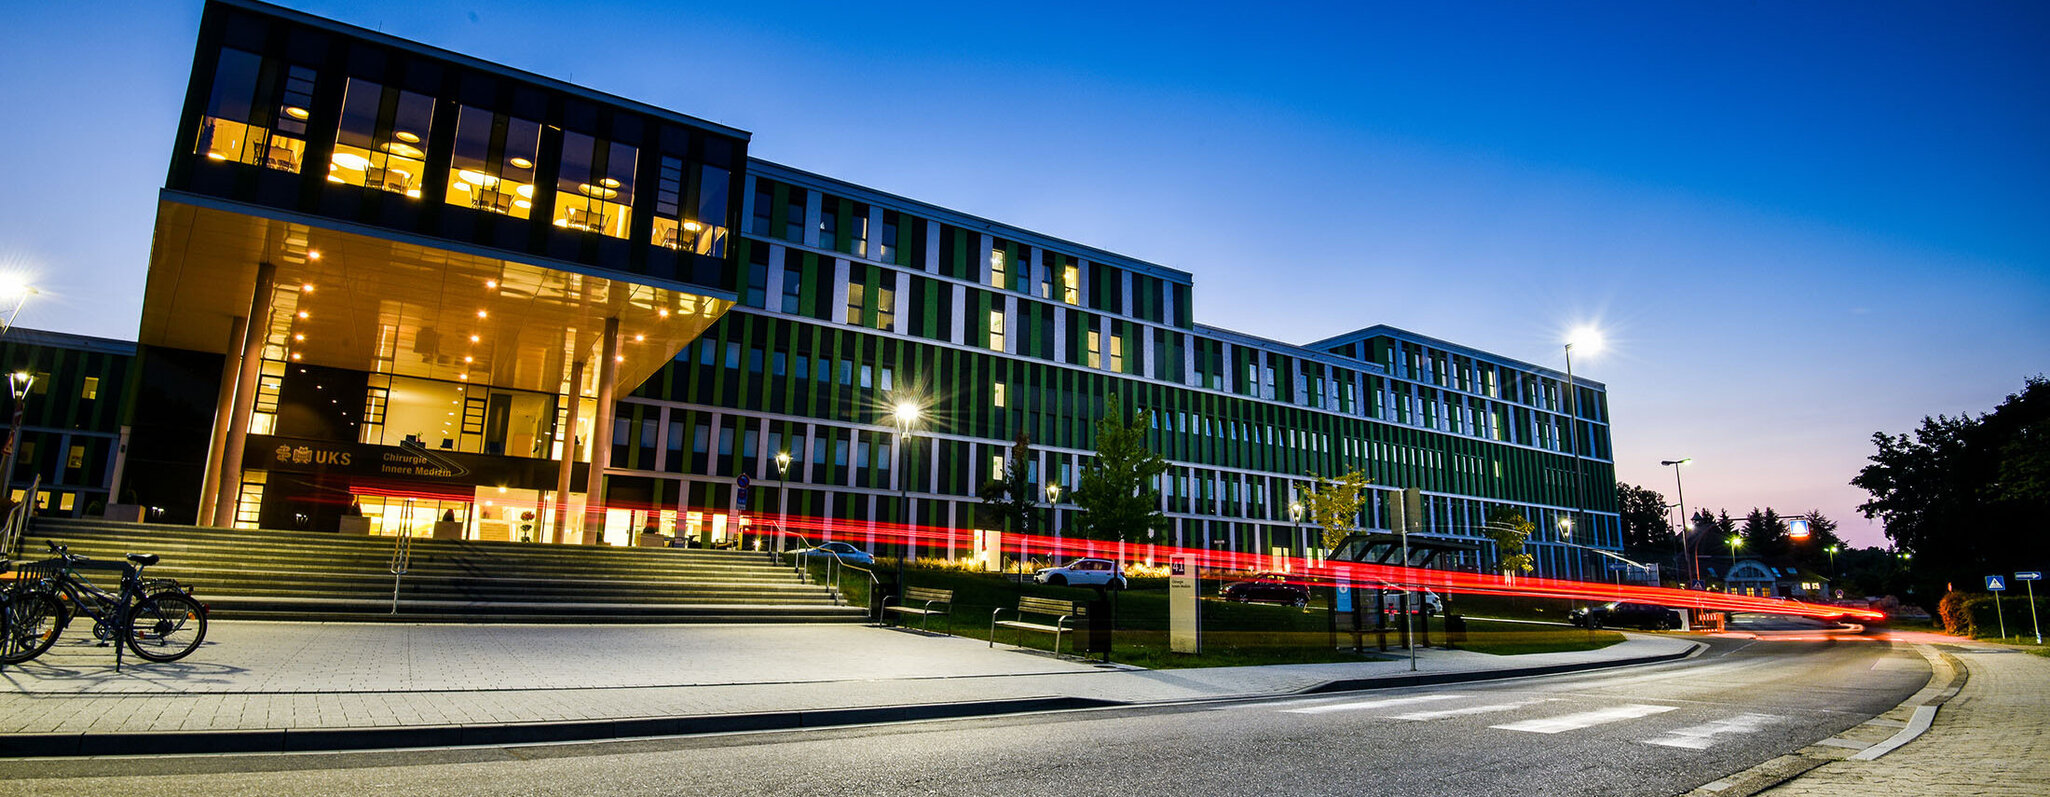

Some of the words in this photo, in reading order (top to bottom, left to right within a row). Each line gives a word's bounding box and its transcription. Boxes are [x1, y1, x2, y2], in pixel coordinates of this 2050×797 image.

[316, 451, 351, 465] UKS
[383, 452, 427, 464] Chirurgie
[382, 464, 412, 474] Innere
[415, 466, 452, 477] Medizin
[1172, 561, 1184, 572] 41
